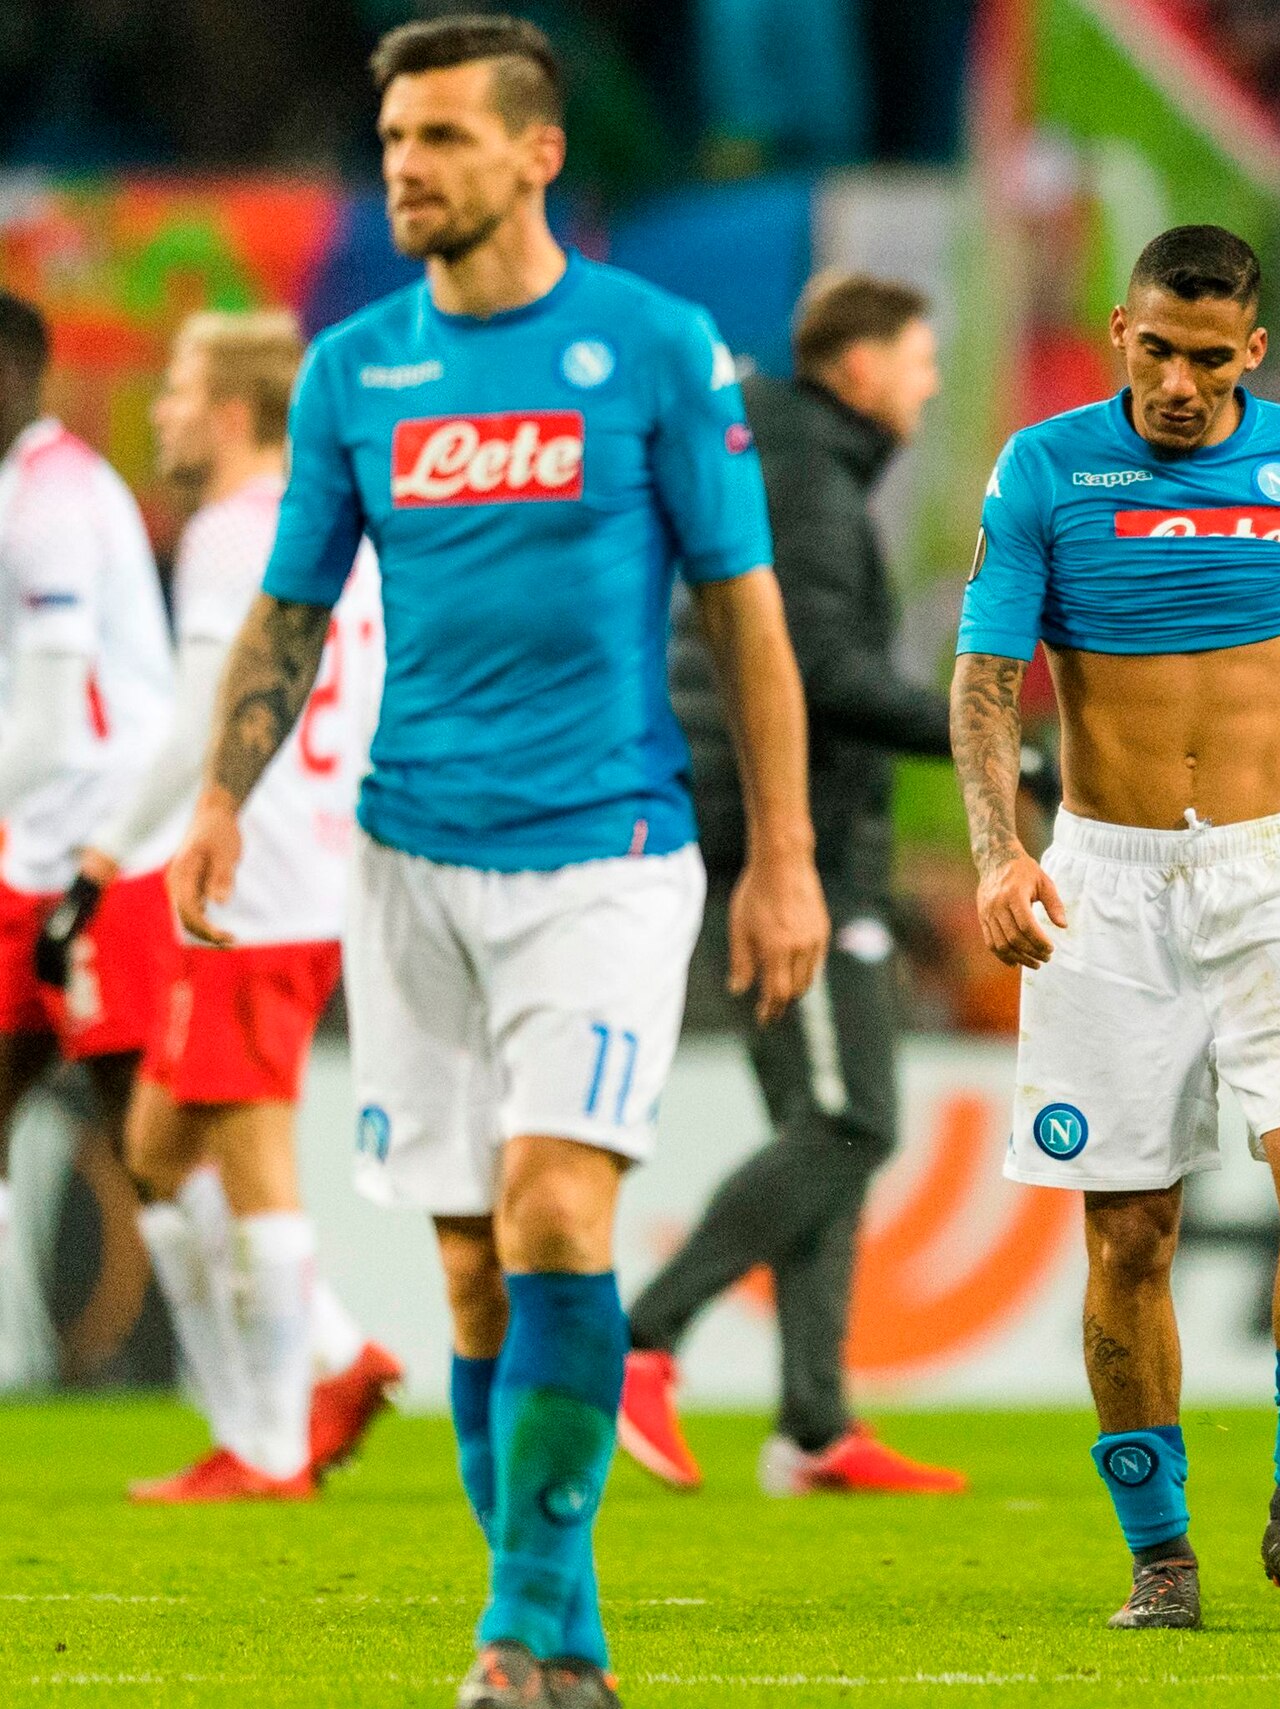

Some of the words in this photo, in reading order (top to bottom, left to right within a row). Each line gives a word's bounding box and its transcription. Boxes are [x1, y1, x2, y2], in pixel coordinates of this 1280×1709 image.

[393, 420, 582, 500] Lete
[1071, 470, 1153, 488] Kappa
[583, 1019, 640, 1126] 11
[1048, 1118, 1072, 1146] N
[1119, 1455, 1140, 1475] N
